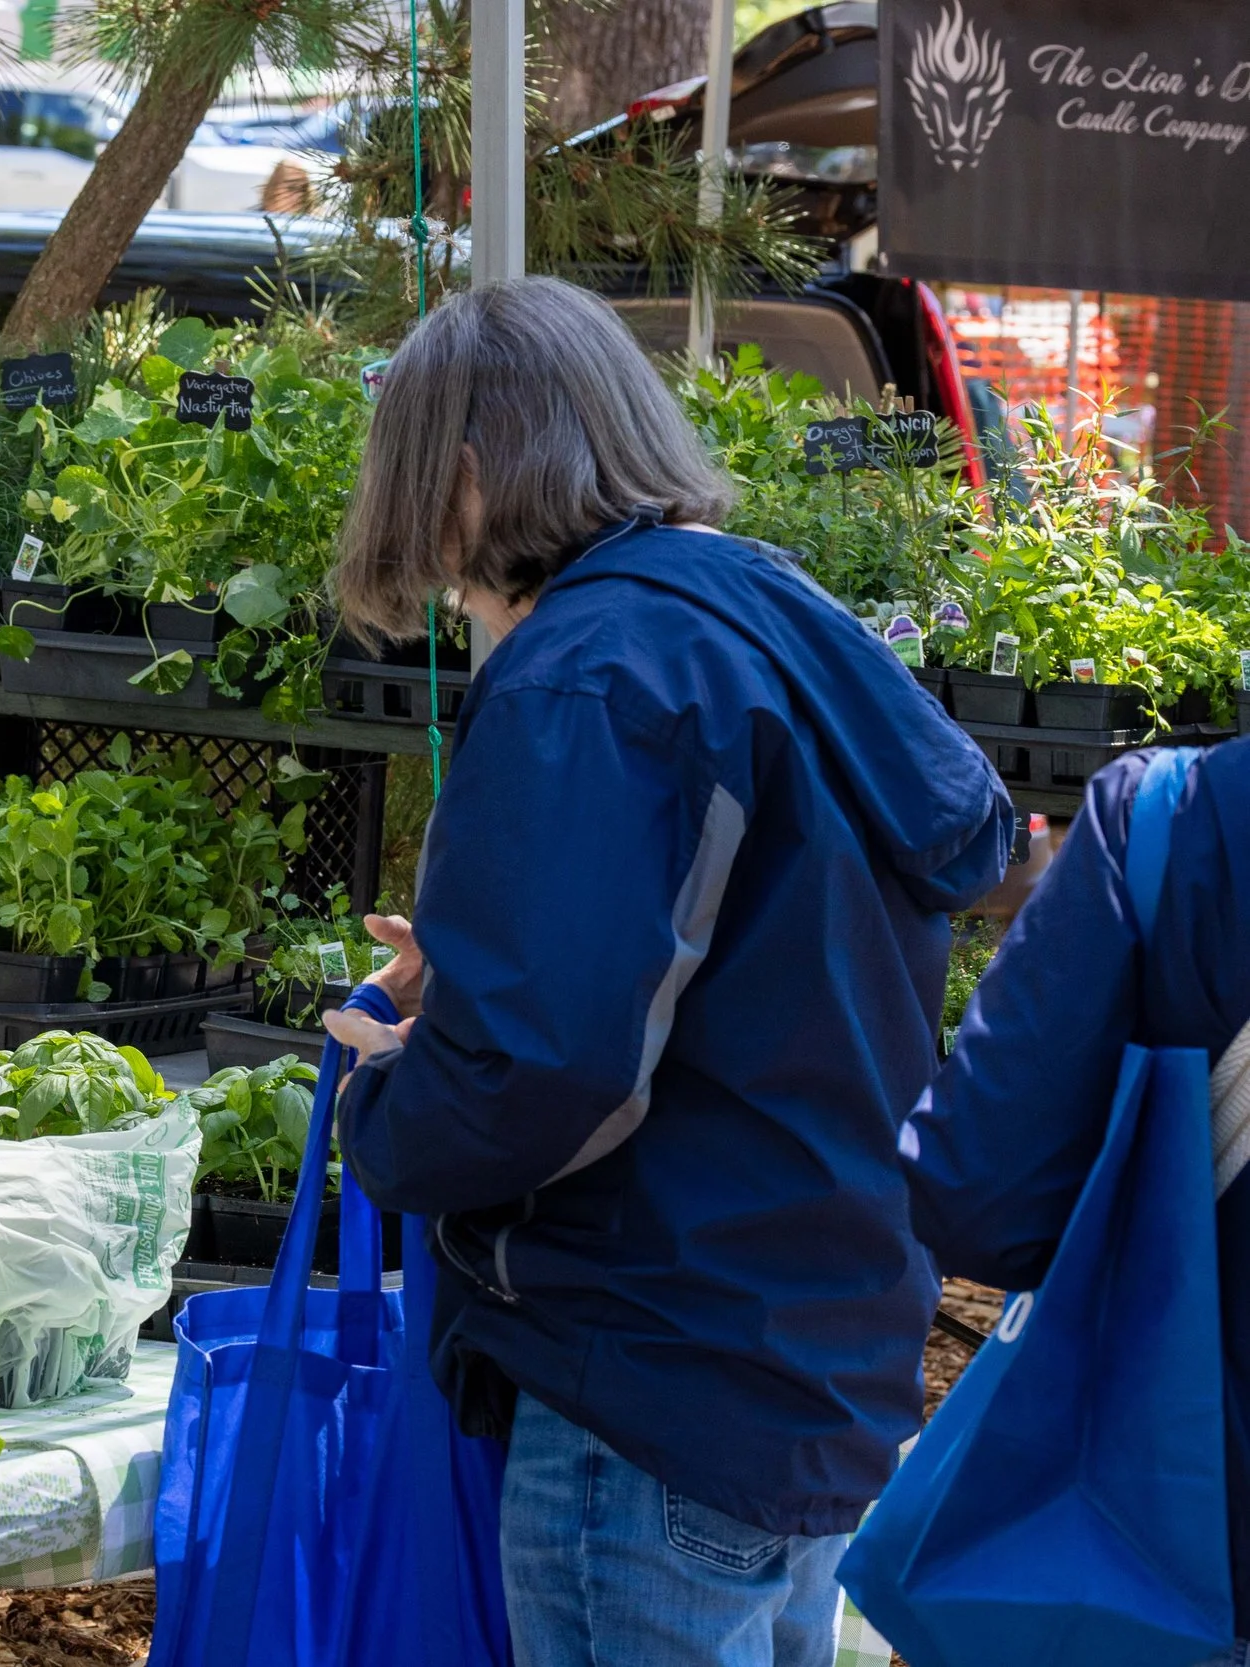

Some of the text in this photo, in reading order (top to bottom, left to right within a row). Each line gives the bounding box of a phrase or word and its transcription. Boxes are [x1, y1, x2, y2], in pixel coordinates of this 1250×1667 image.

[1028, 44, 1096, 88] The
[1101, 51, 1215, 97] Lion's
[1056, 97, 1249, 155] Candle Company
[9, 369, 63, 387] Chives
[186, 379, 249, 400] Variegated
[116, 1199, 130, 1221] USA
[137, 1191, 162, 1285] COMPOSTABLE
